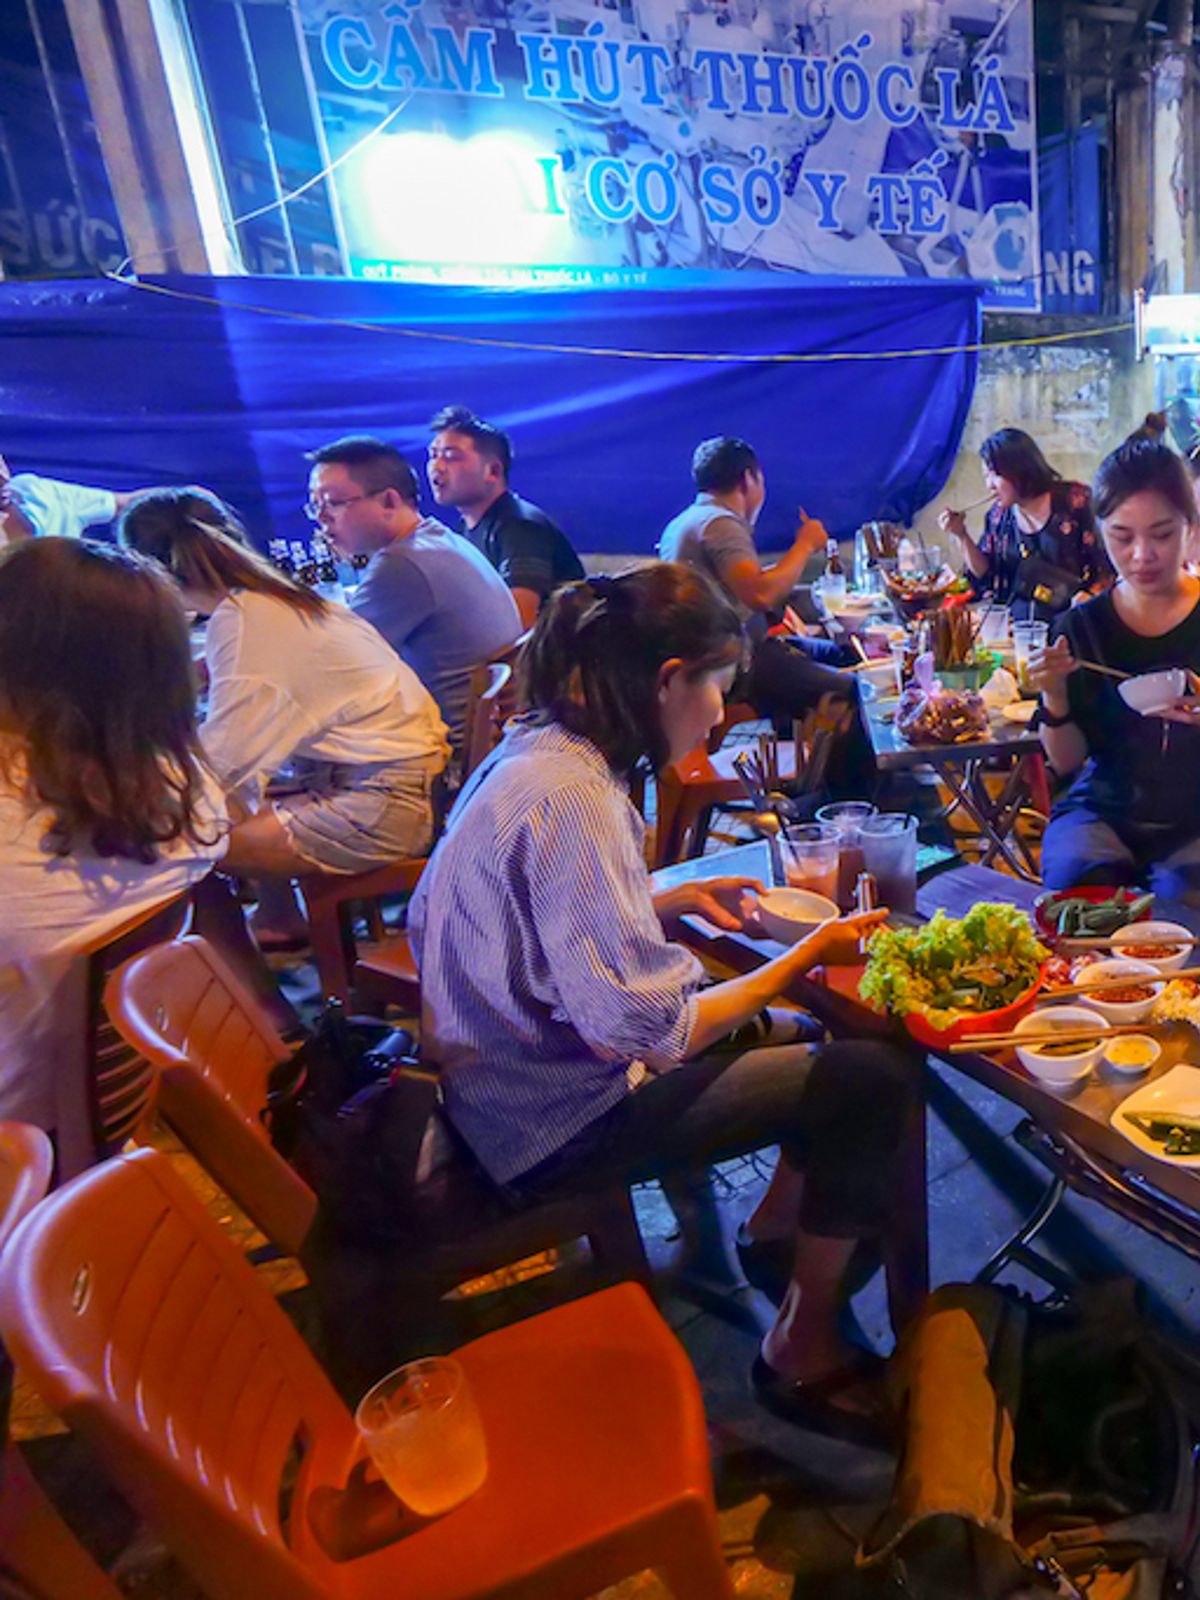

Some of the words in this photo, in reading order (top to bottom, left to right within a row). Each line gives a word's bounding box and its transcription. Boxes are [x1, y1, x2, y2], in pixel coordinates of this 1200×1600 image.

[323, 0, 504, 96] CẤM
[517, 21, 674, 106] HÚT
[692, 33, 918, 124] THUỐC
[935, 56, 1016, 132] LÁ
[587, 152, 678, 222] CƠ
[701, 144, 783, 225] SỞ
[804, 172, 847, 229] Y
[866, 149, 948, 233] TẾ
